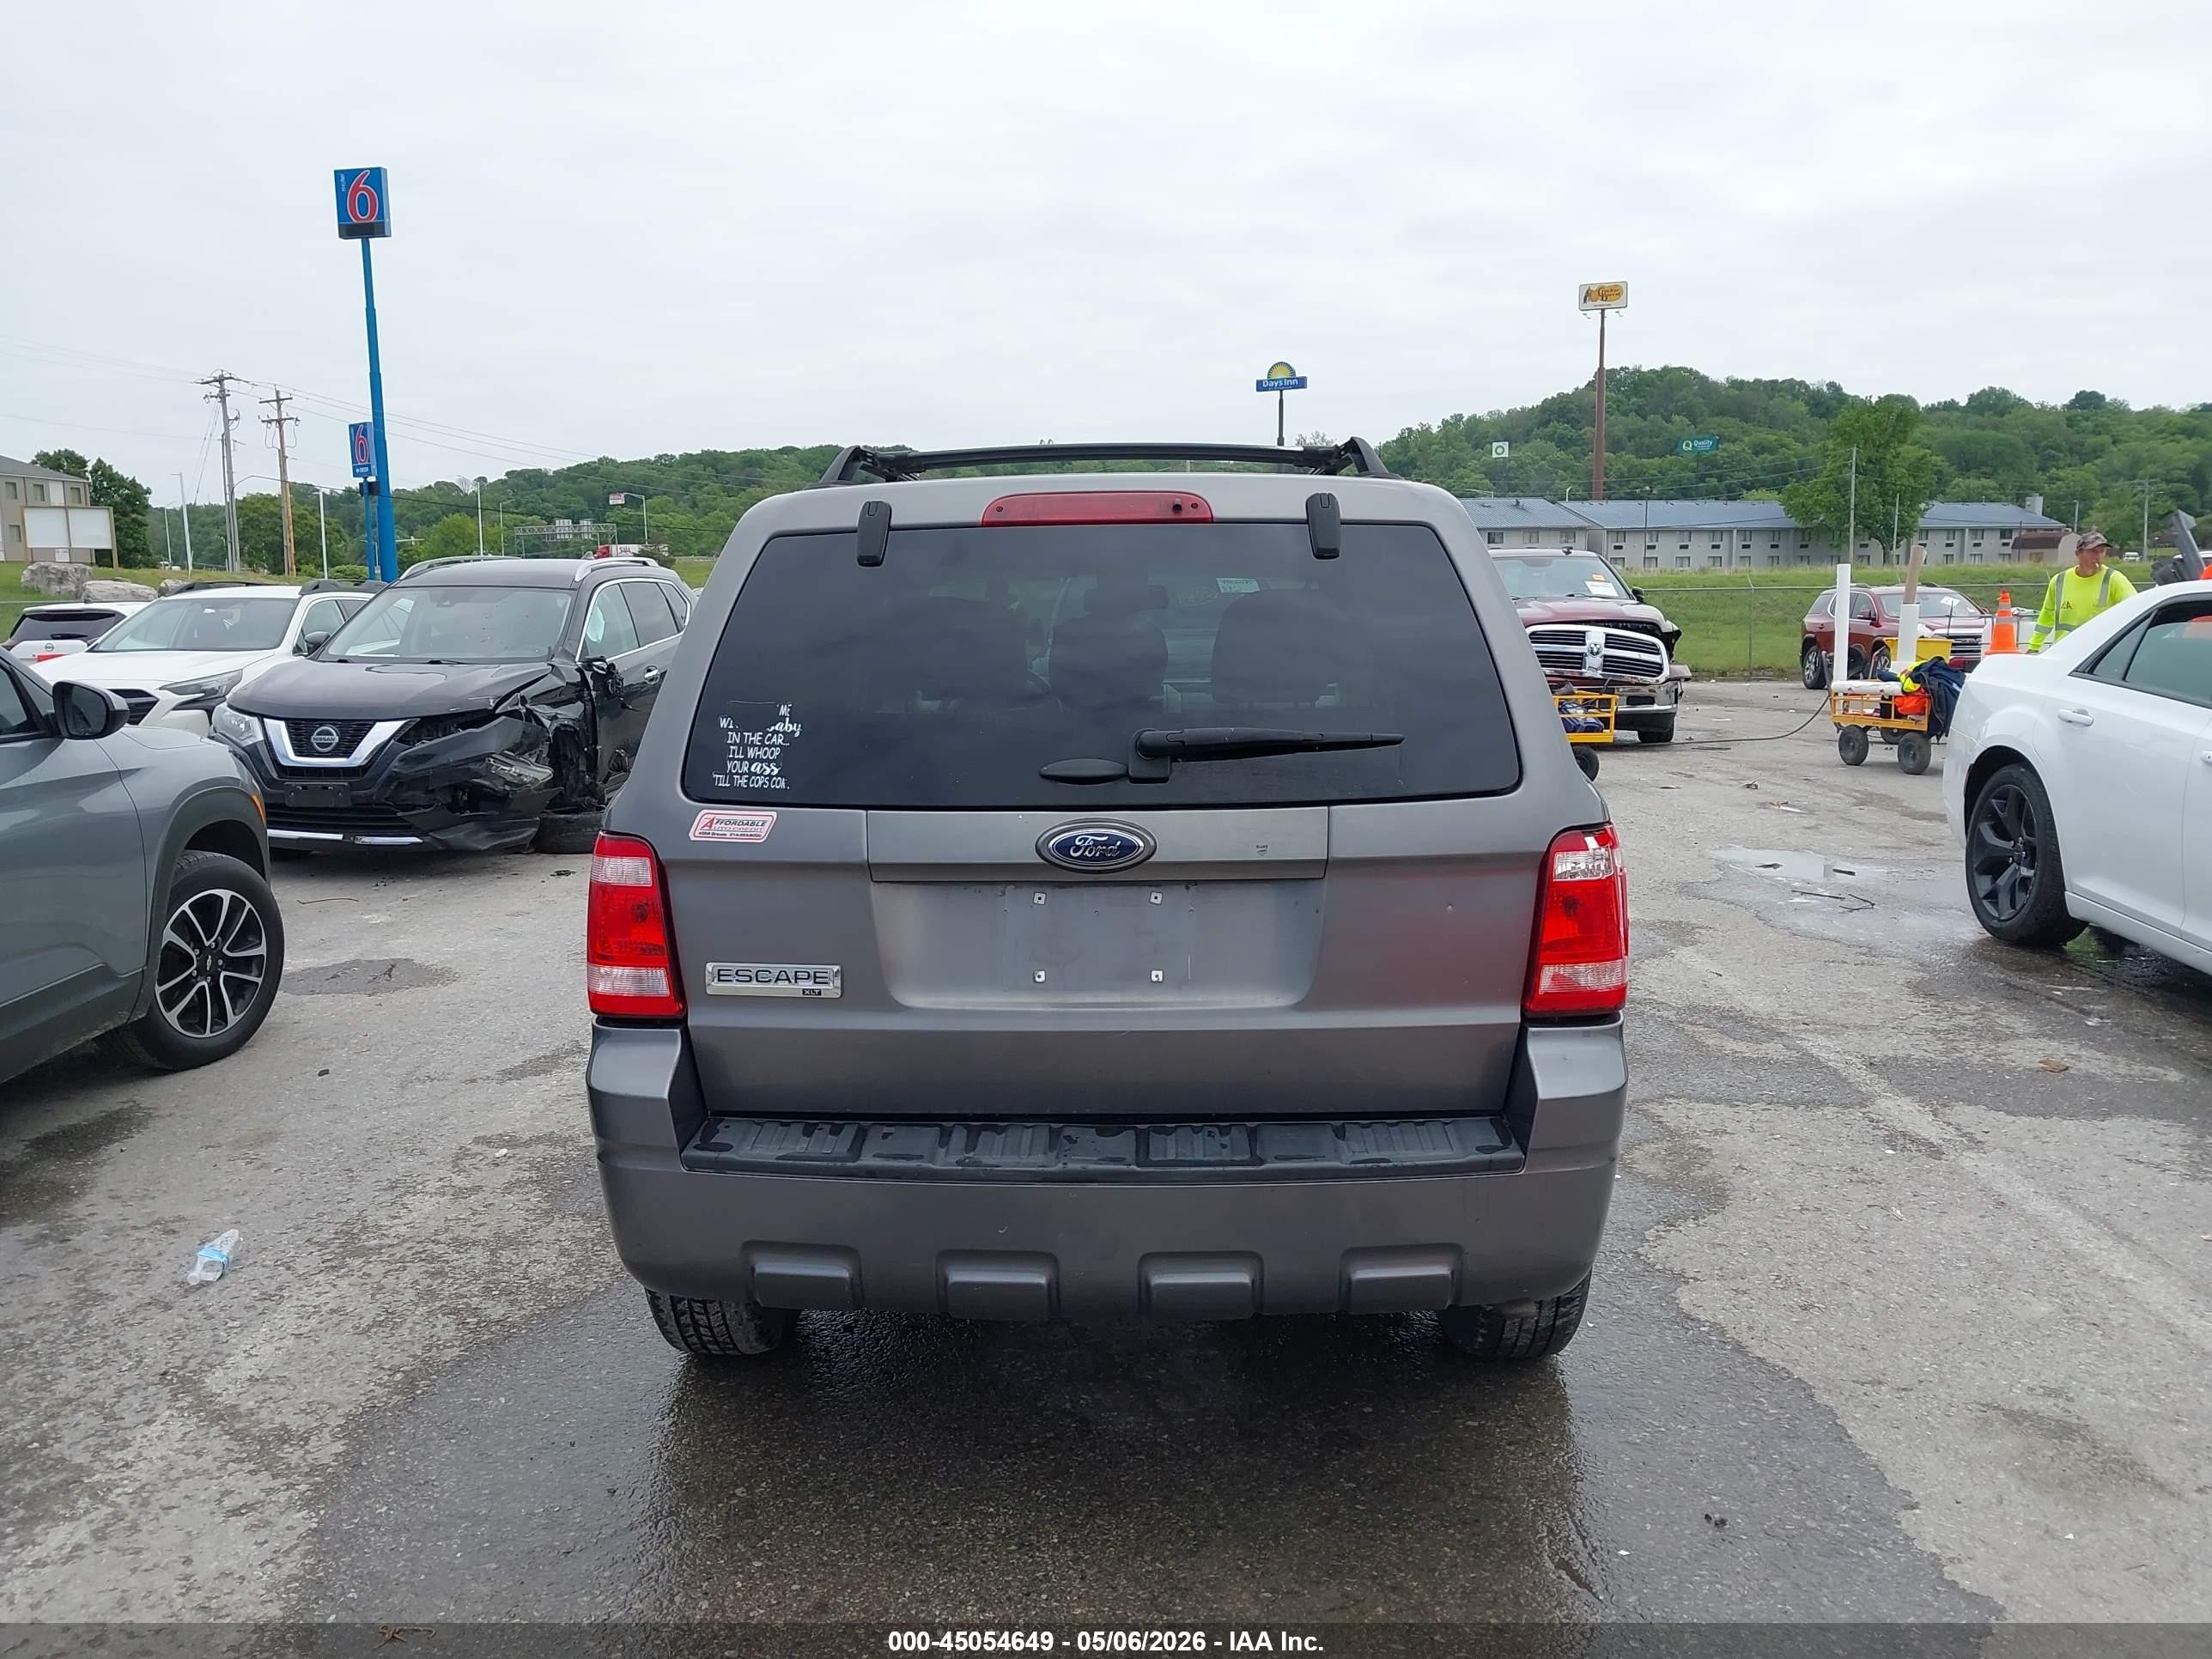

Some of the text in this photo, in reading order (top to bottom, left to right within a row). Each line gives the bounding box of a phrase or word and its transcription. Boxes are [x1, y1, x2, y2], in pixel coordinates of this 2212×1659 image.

[347, 170, 379, 222] 6
[1262, 380, 1283, 388] Days
[356, 424, 369, 465] 6
[1693, 439, 1713, 447] Quality
[766, 717, 803, 738] aby
[726, 732, 740, 744] IN
[743, 732, 763, 745] THE
[747, 746, 781, 759] WHOOP
[726, 760, 781, 775] YOUR ass
[733, 775, 749, 787] THE
[749, 775, 769, 788] COPS
[1069, 835, 1122, 857] Ford
[717, 968, 830, 985] ESCAPE
